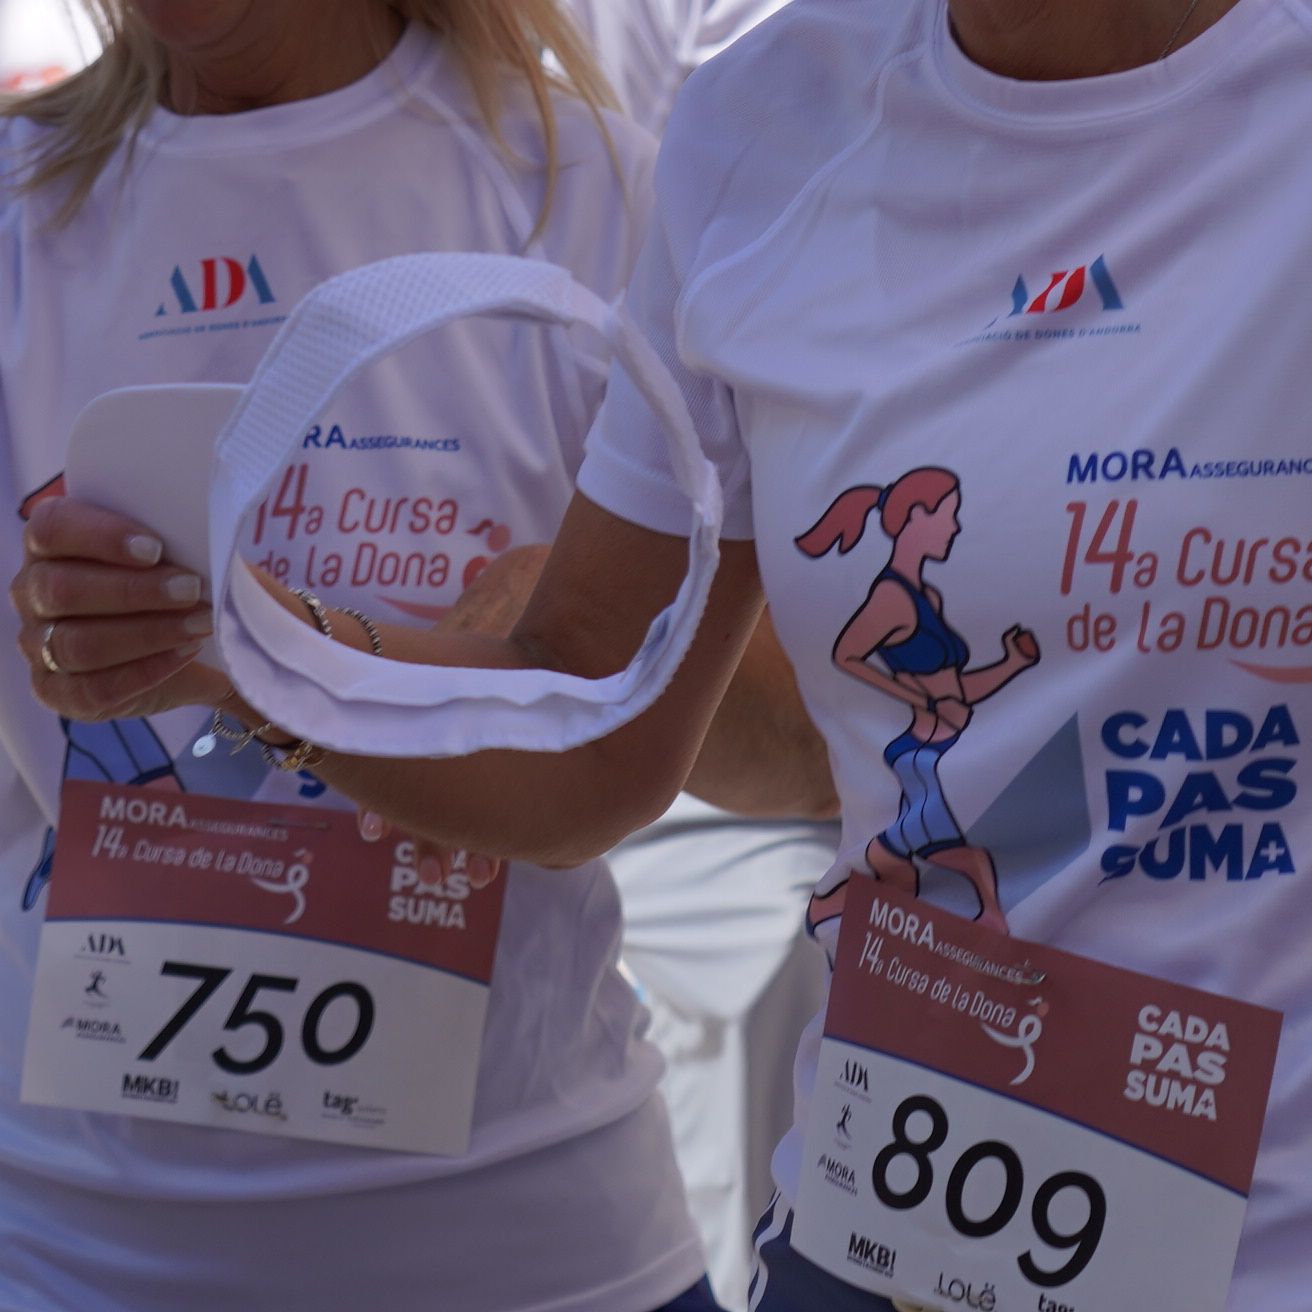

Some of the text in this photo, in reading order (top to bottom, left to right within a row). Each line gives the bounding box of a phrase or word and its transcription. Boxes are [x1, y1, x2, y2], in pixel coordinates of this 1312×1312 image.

[154, 253, 276, 316] ADA
[348, 435, 461, 452] ASSEGURANCES
[1066, 447, 1187, 485] MORA
[336, 487, 460, 536] Cursa
[304, 543, 344, 589] la
[350, 541, 451, 588] Dona
[1060, 498, 1159, 597] 14a
[1065, 602, 1118, 654] de
[1136, 599, 1187, 654] la
[1100, 702, 1301, 763] CADA
[99, 795, 188, 829] MORA
[1104, 756, 1299, 833] PAS
[132, 838, 187, 867] Cursa
[189, 847, 212, 870] de
[215, 849, 237, 873] la
[238, 851, 286, 879] Dona
[1098, 821, 1297, 886] SUMA
[387, 894, 467, 930] SUMA
[869, 896, 936, 951] MORA
[136, 960, 376, 1076] 750
[886, 955, 931, 994] Cursa
[929, 975, 953, 1005] de
[951, 983, 971, 1013] la
[968, 989, 1018, 1029] Dona
[1137, 1003, 1231, 1052] CADA
[1129, 1031, 1228, 1086] PAS
[1122, 1068, 1218, 1121] SUMA
[871, 1093, 1107, 1288] 809
